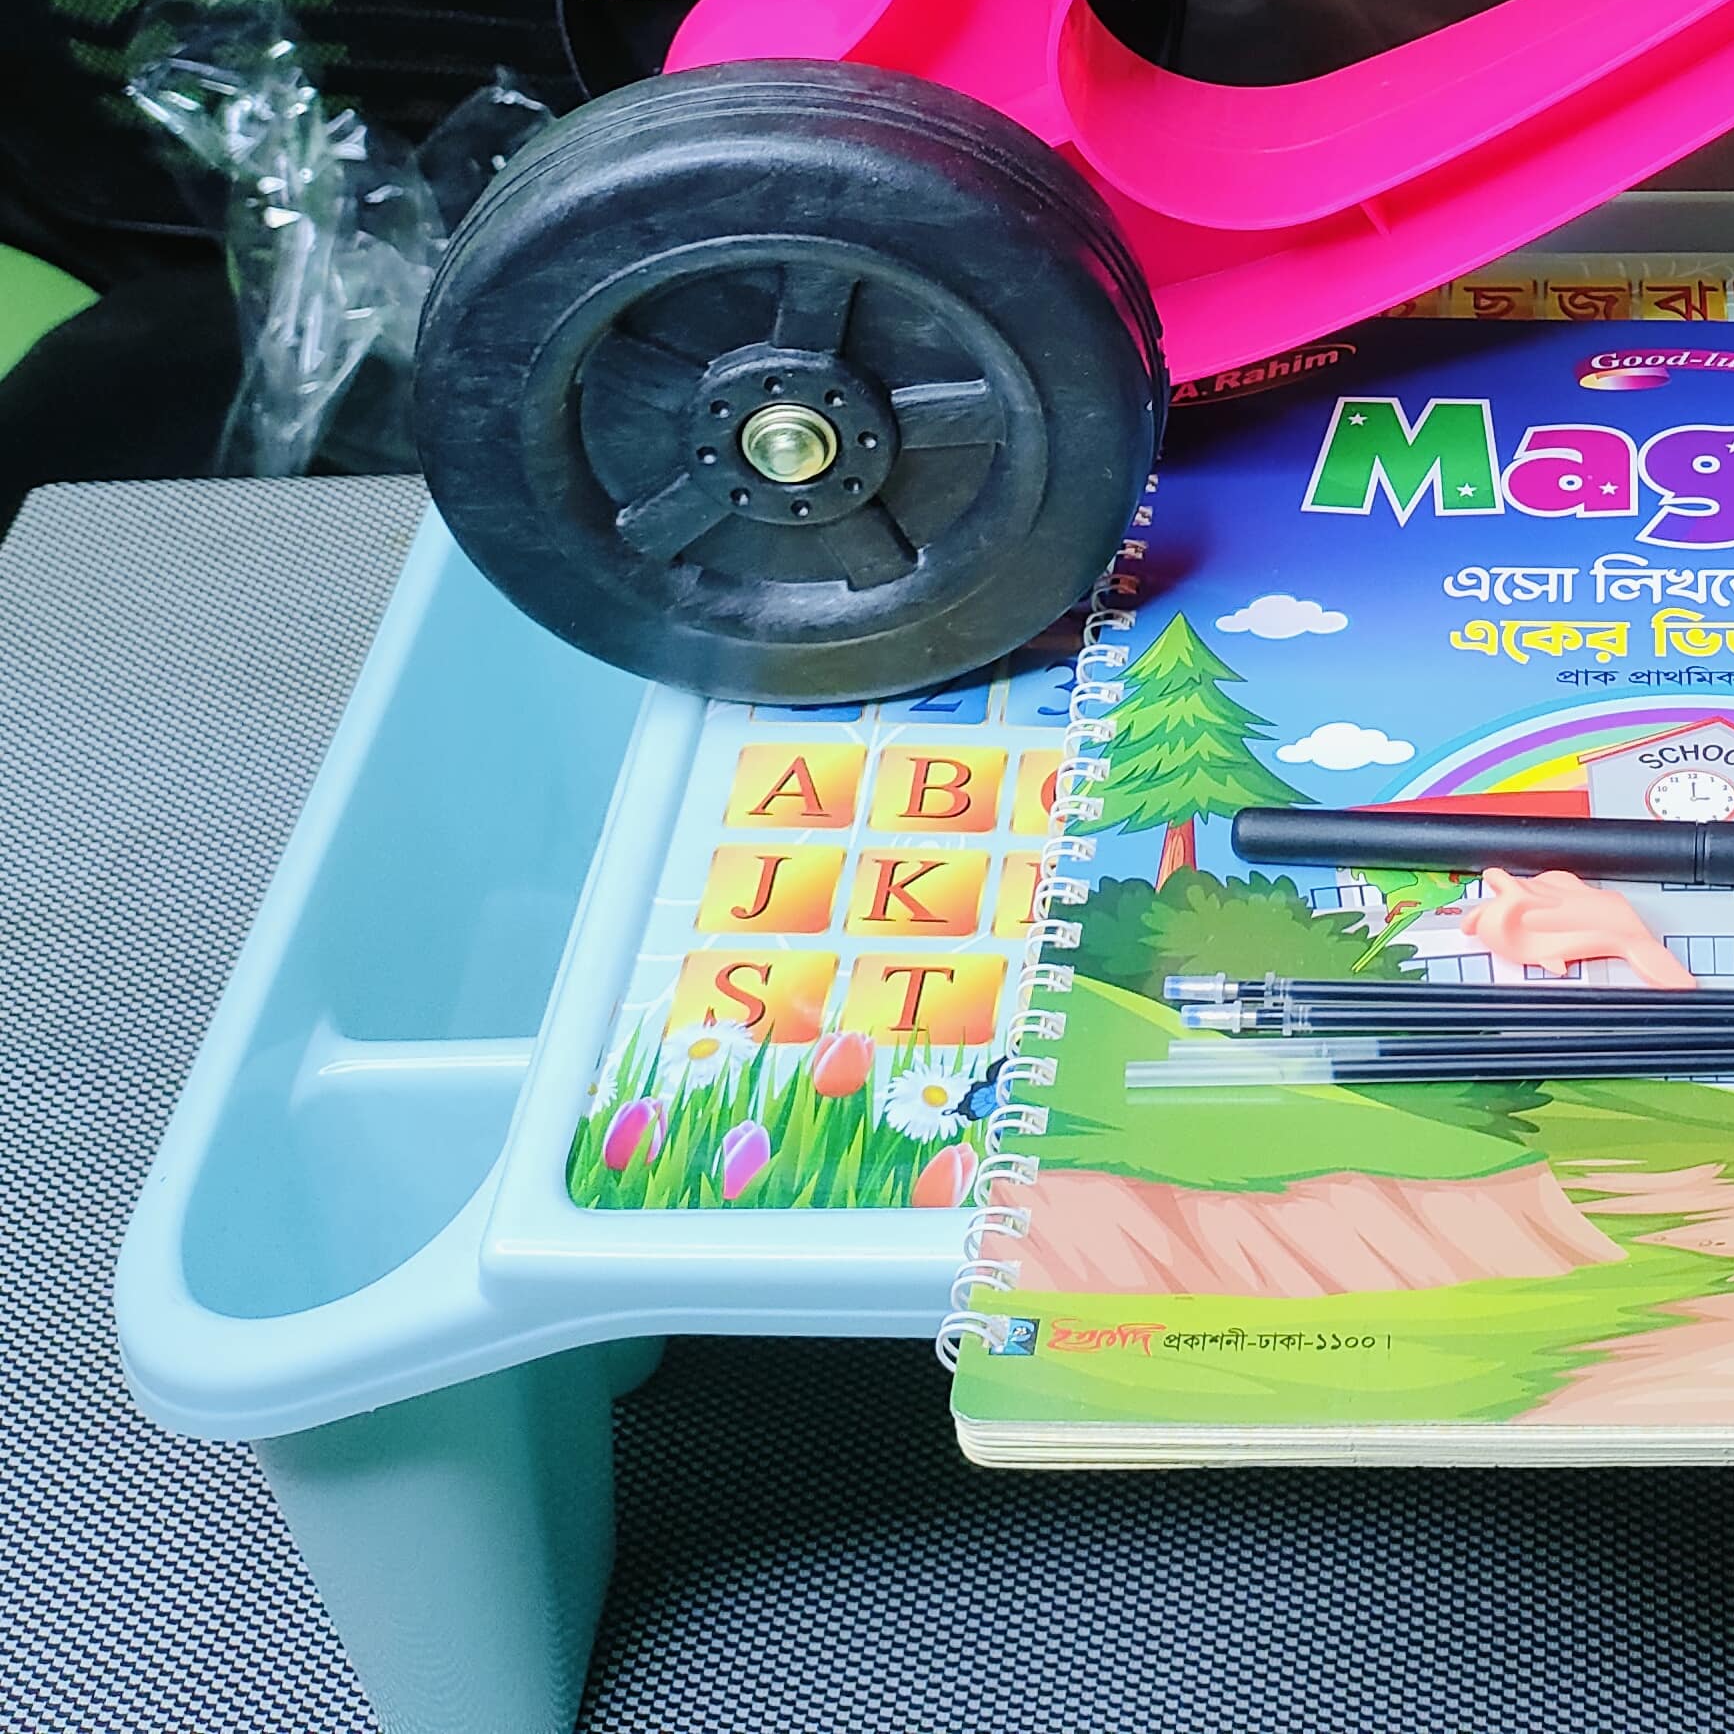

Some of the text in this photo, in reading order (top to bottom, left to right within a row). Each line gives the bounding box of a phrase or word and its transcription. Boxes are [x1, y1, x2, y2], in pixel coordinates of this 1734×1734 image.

[1550, 285, 1627, 321] জ
[1646, 280, 1719, 321] ঝ
[1214, 349, 1340, 392] Rahim
[1442, 566, 1580, 607] এসো
[1449, 617, 1631, 665] একের
[1556, 669, 1619, 687] প্রাক
[748, 755, 832, 817] A
[898, 756, 973, 819] B
[730, 855, 792, 921] J
[863, 859, 949, 924] K
[703, 962, 955, 1032] S T
